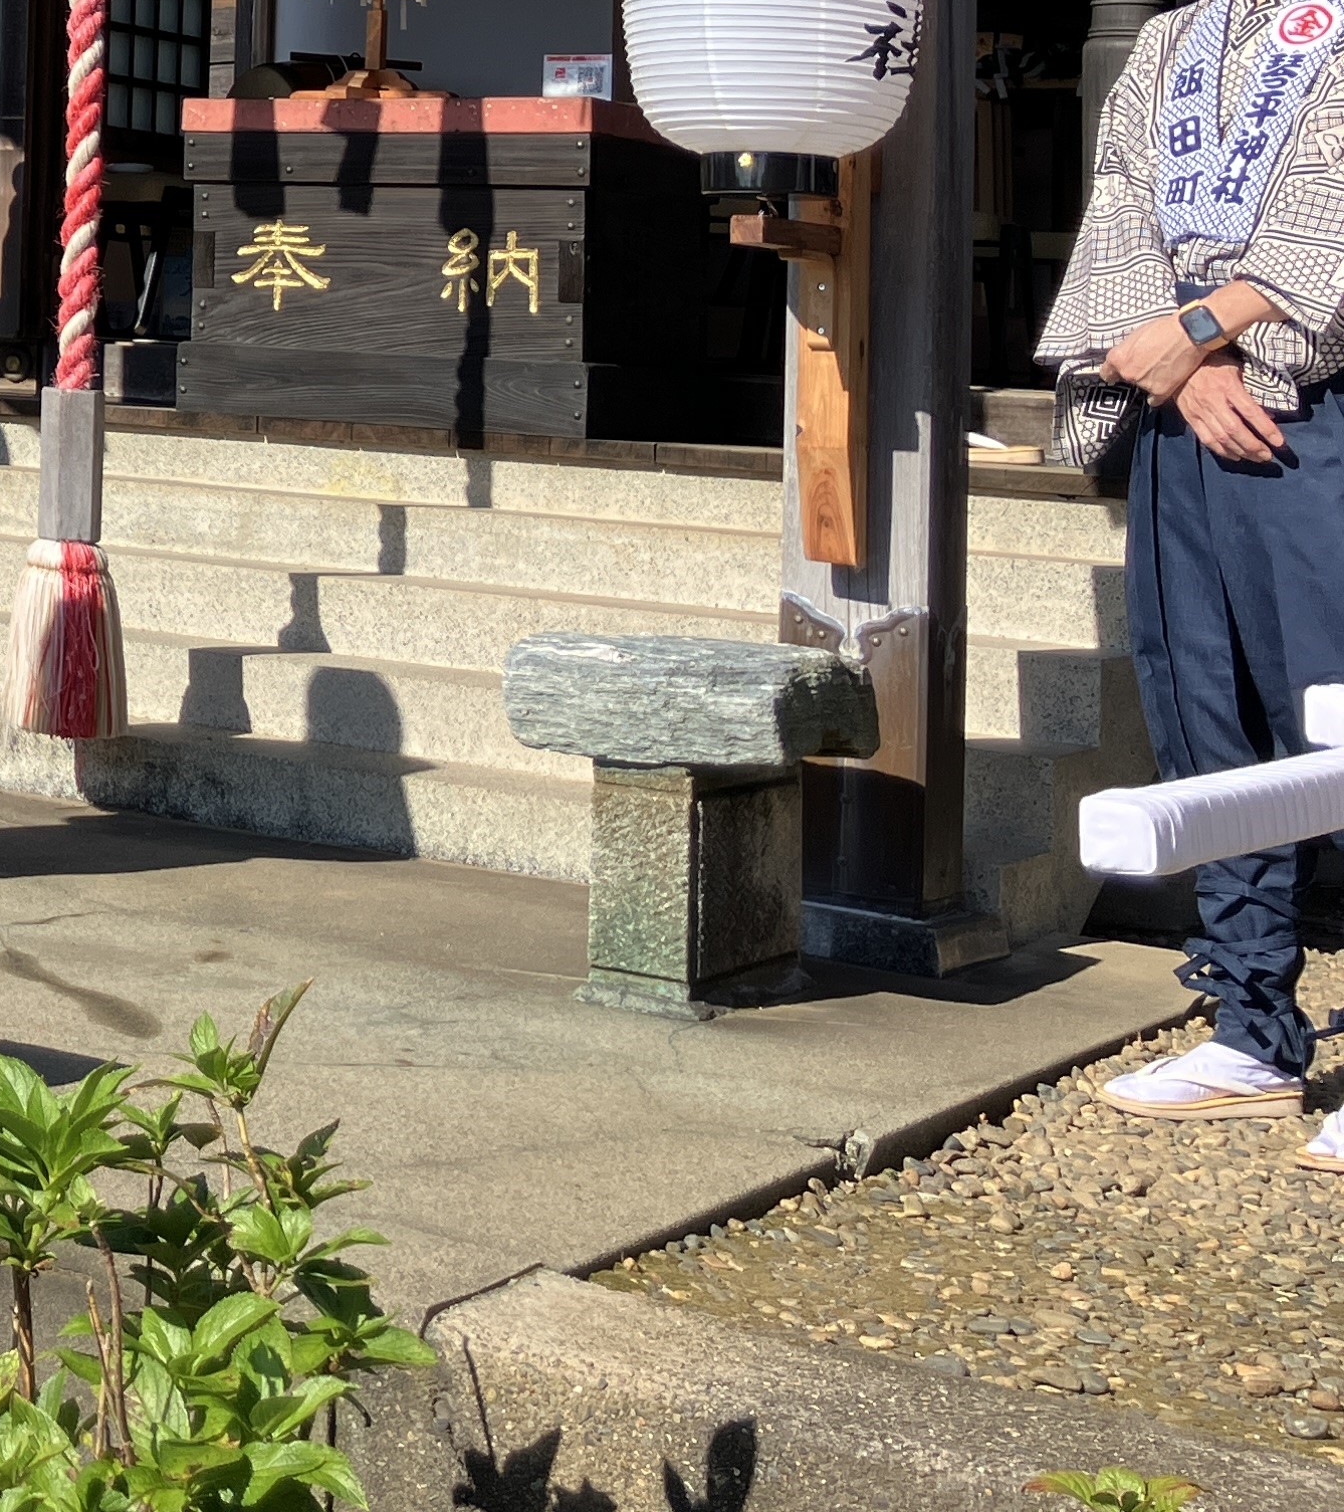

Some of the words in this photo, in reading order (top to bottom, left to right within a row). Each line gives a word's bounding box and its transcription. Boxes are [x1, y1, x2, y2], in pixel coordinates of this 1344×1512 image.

[1288, 9, 1323, 38] 金
[1165, 57, 1205, 206] 飯田町
[1211, 53, 1306, 205] 琴平神社
